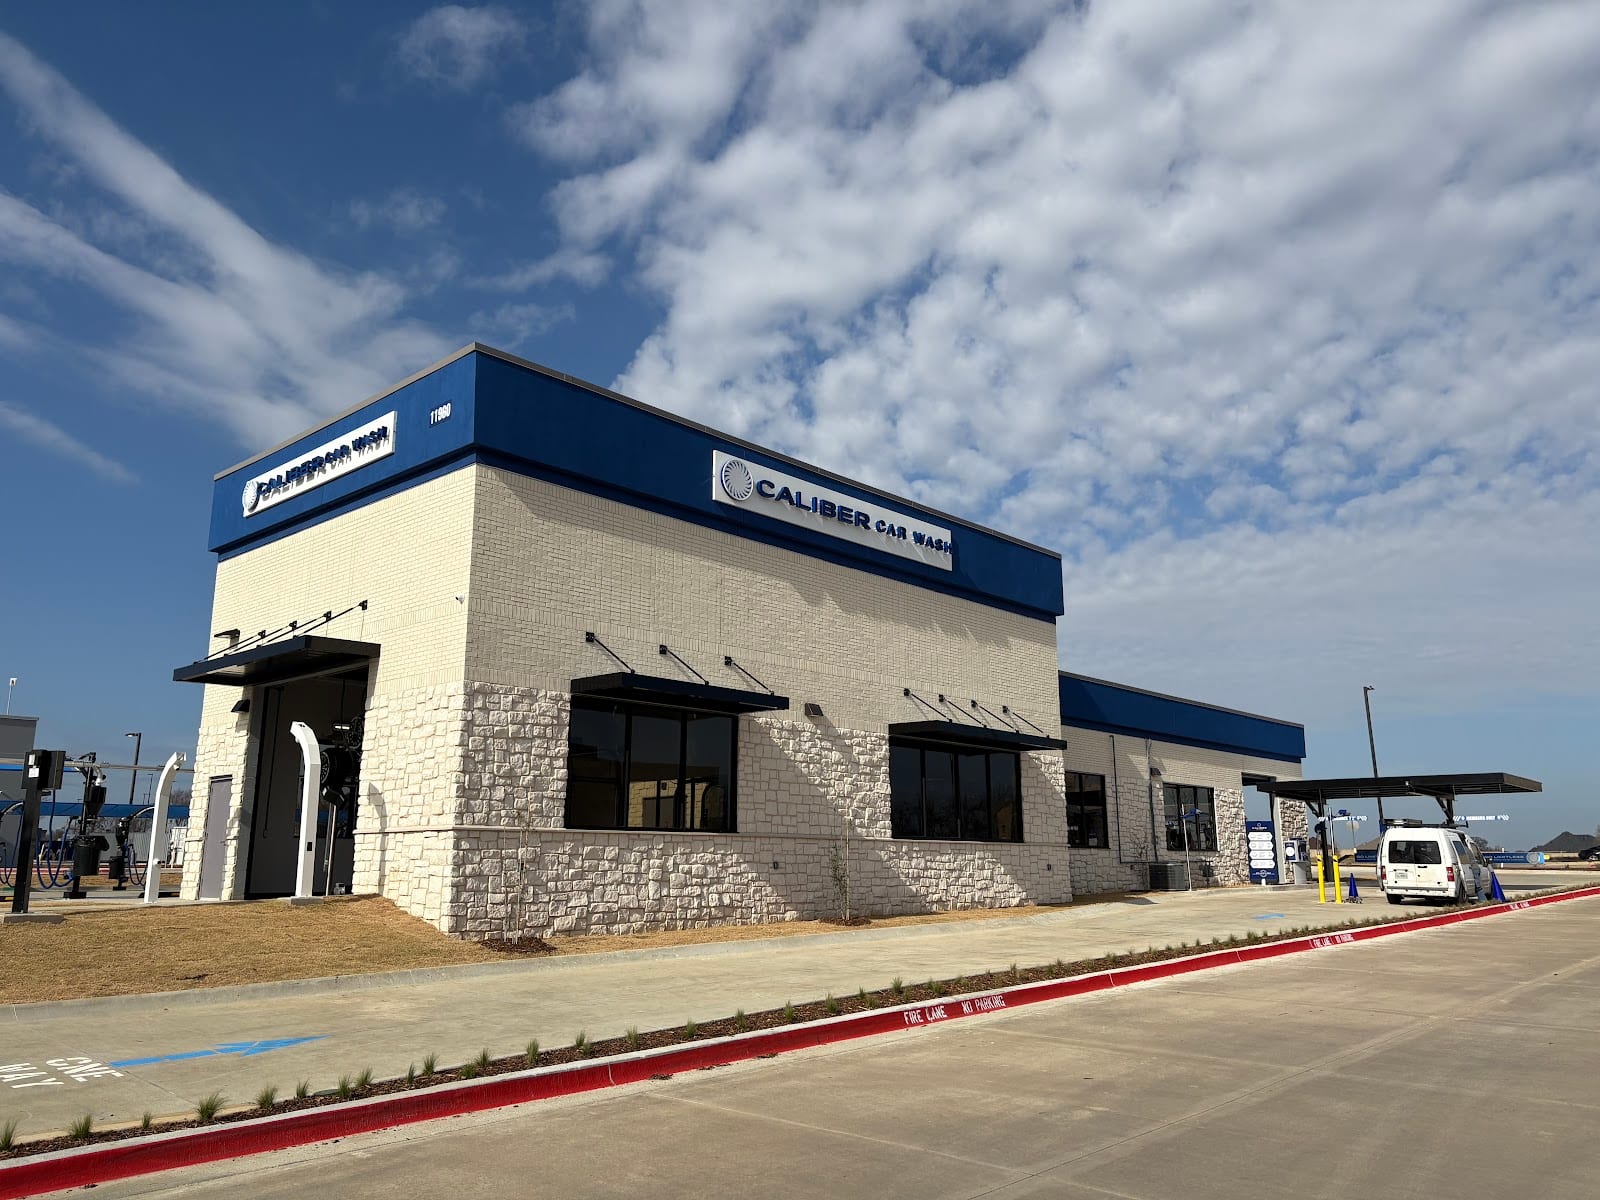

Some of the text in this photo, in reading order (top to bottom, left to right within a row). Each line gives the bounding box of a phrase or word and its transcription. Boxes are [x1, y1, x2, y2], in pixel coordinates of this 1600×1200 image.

[257, 426, 388, 496] CALIBER CAR WASH
[756, 479, 953, 555] CALIBER CAR WASH
[903, 995, 1007, 1025] FIRE LANE NO PARKING
[45, 1056, 124, 1082] ONE
